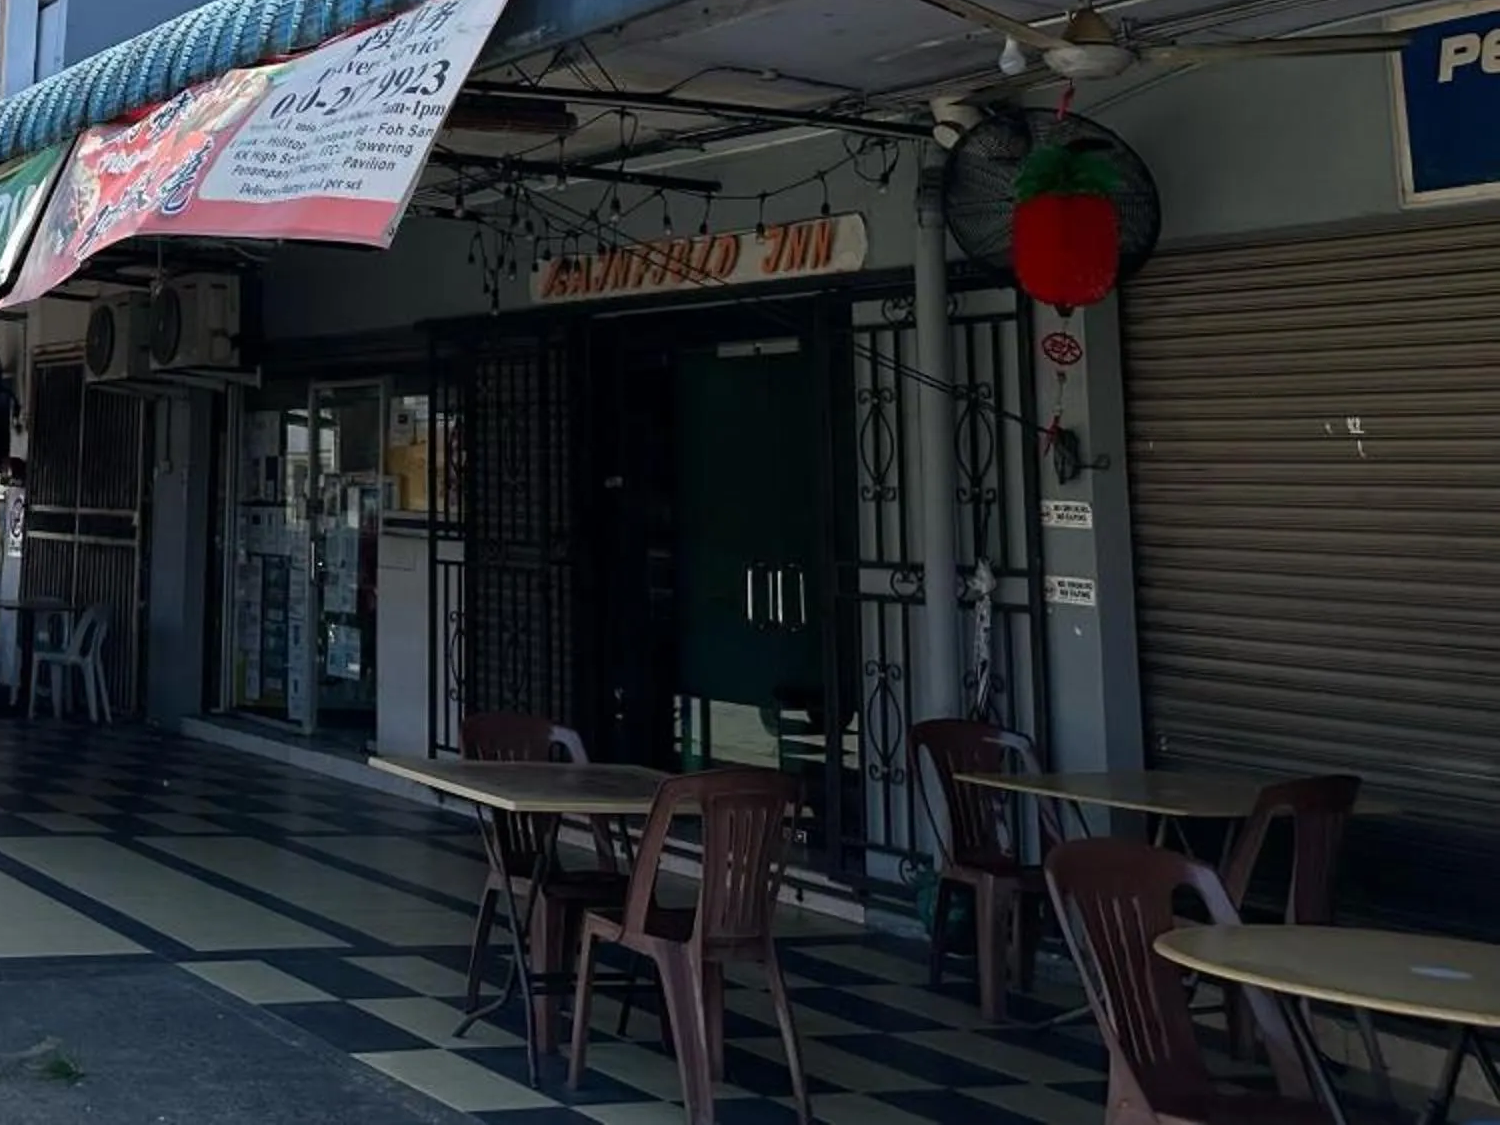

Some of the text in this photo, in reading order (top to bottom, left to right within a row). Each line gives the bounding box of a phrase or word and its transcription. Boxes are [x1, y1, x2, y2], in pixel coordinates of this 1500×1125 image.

[377, 122, 404, 136] Foh
[341, 156, 397, 172] Pavilion
[761, 221, 834, 274] INN
